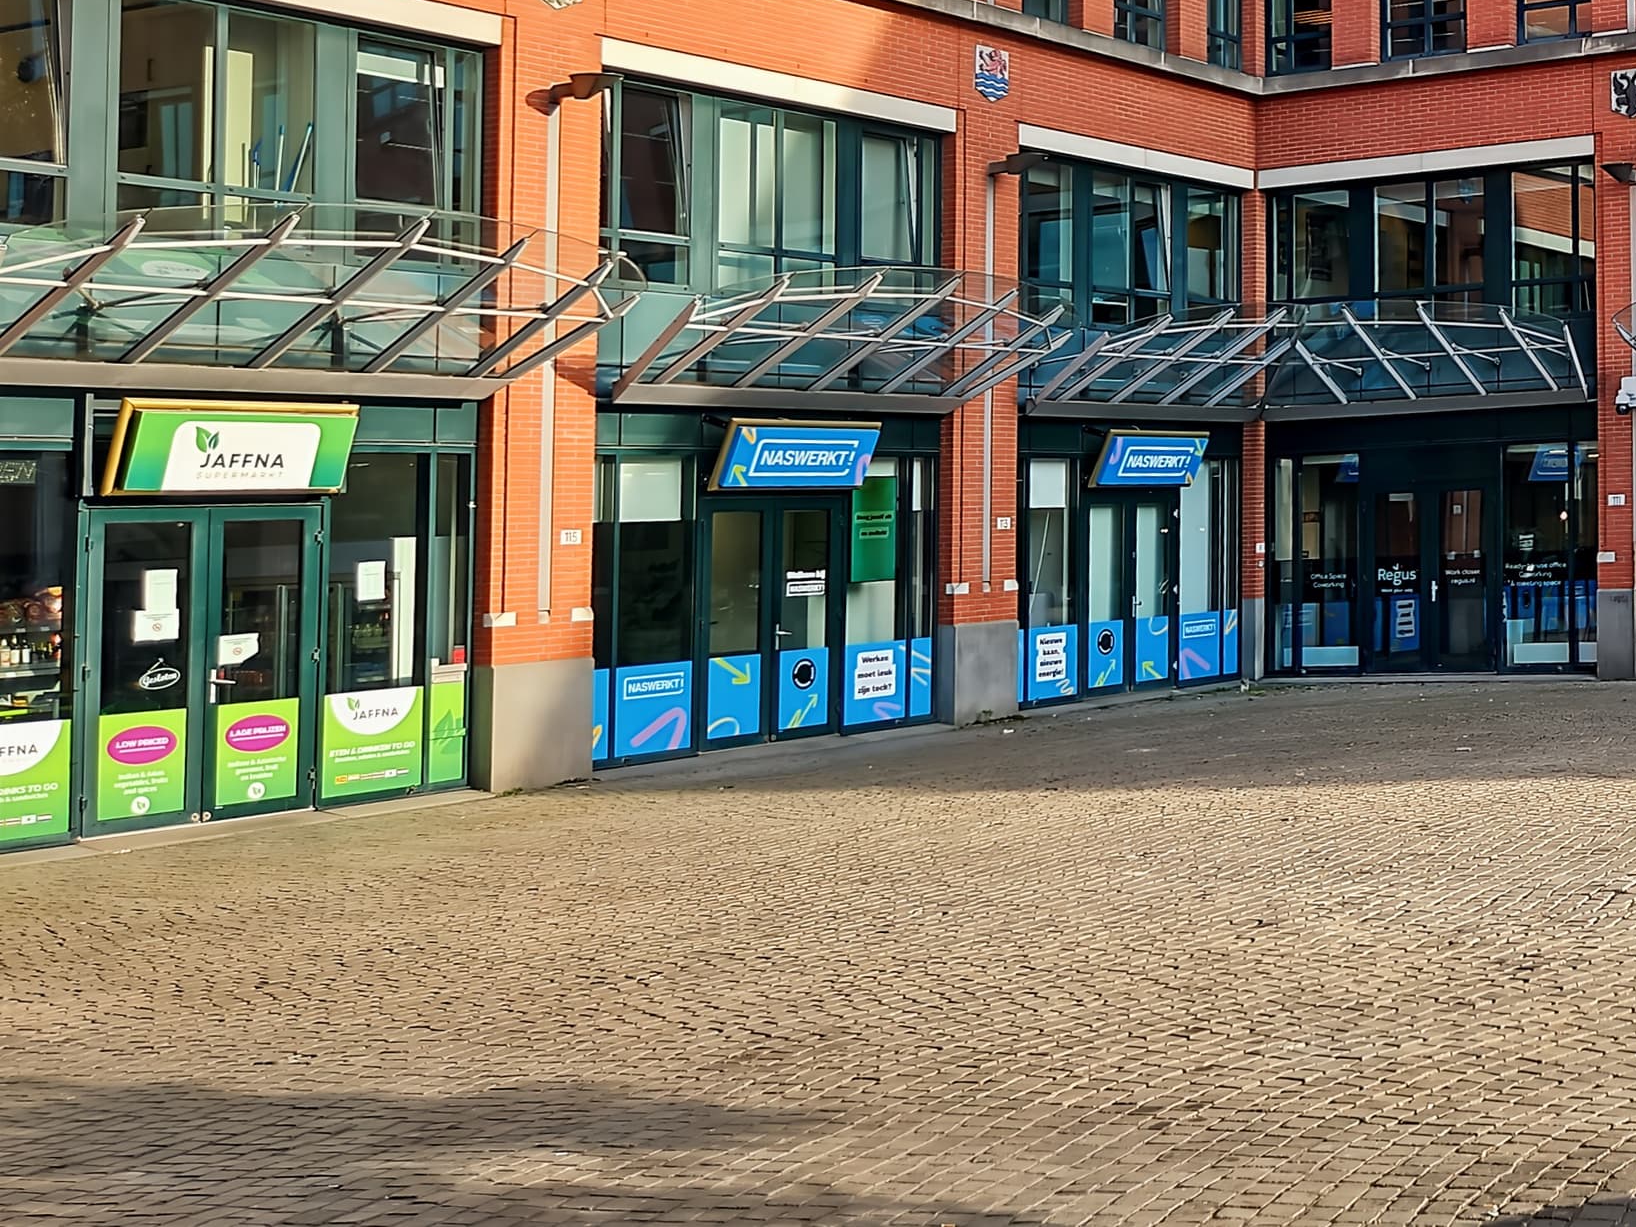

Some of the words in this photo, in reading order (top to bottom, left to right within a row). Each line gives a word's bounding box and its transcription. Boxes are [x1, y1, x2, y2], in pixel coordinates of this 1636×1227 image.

[199, 453, 284, 468] JAFFNA
[760, 450, 856, 466] NASWERKT!
[1126, 455, 1191, 468] NASWERKT!
[565, 531, 578, 542] 115
[1377, 567, 1417, 586] Regus
[627, 677, 684, 694] NASWERKT!
[353, 707, 399, 721] JAFFNA
[115, 739, 137, 750] LOW
[137, 736, 169, 748] PRICED
[28, 783, 42, 793] TO
[43, 782, 58, 791] GO
